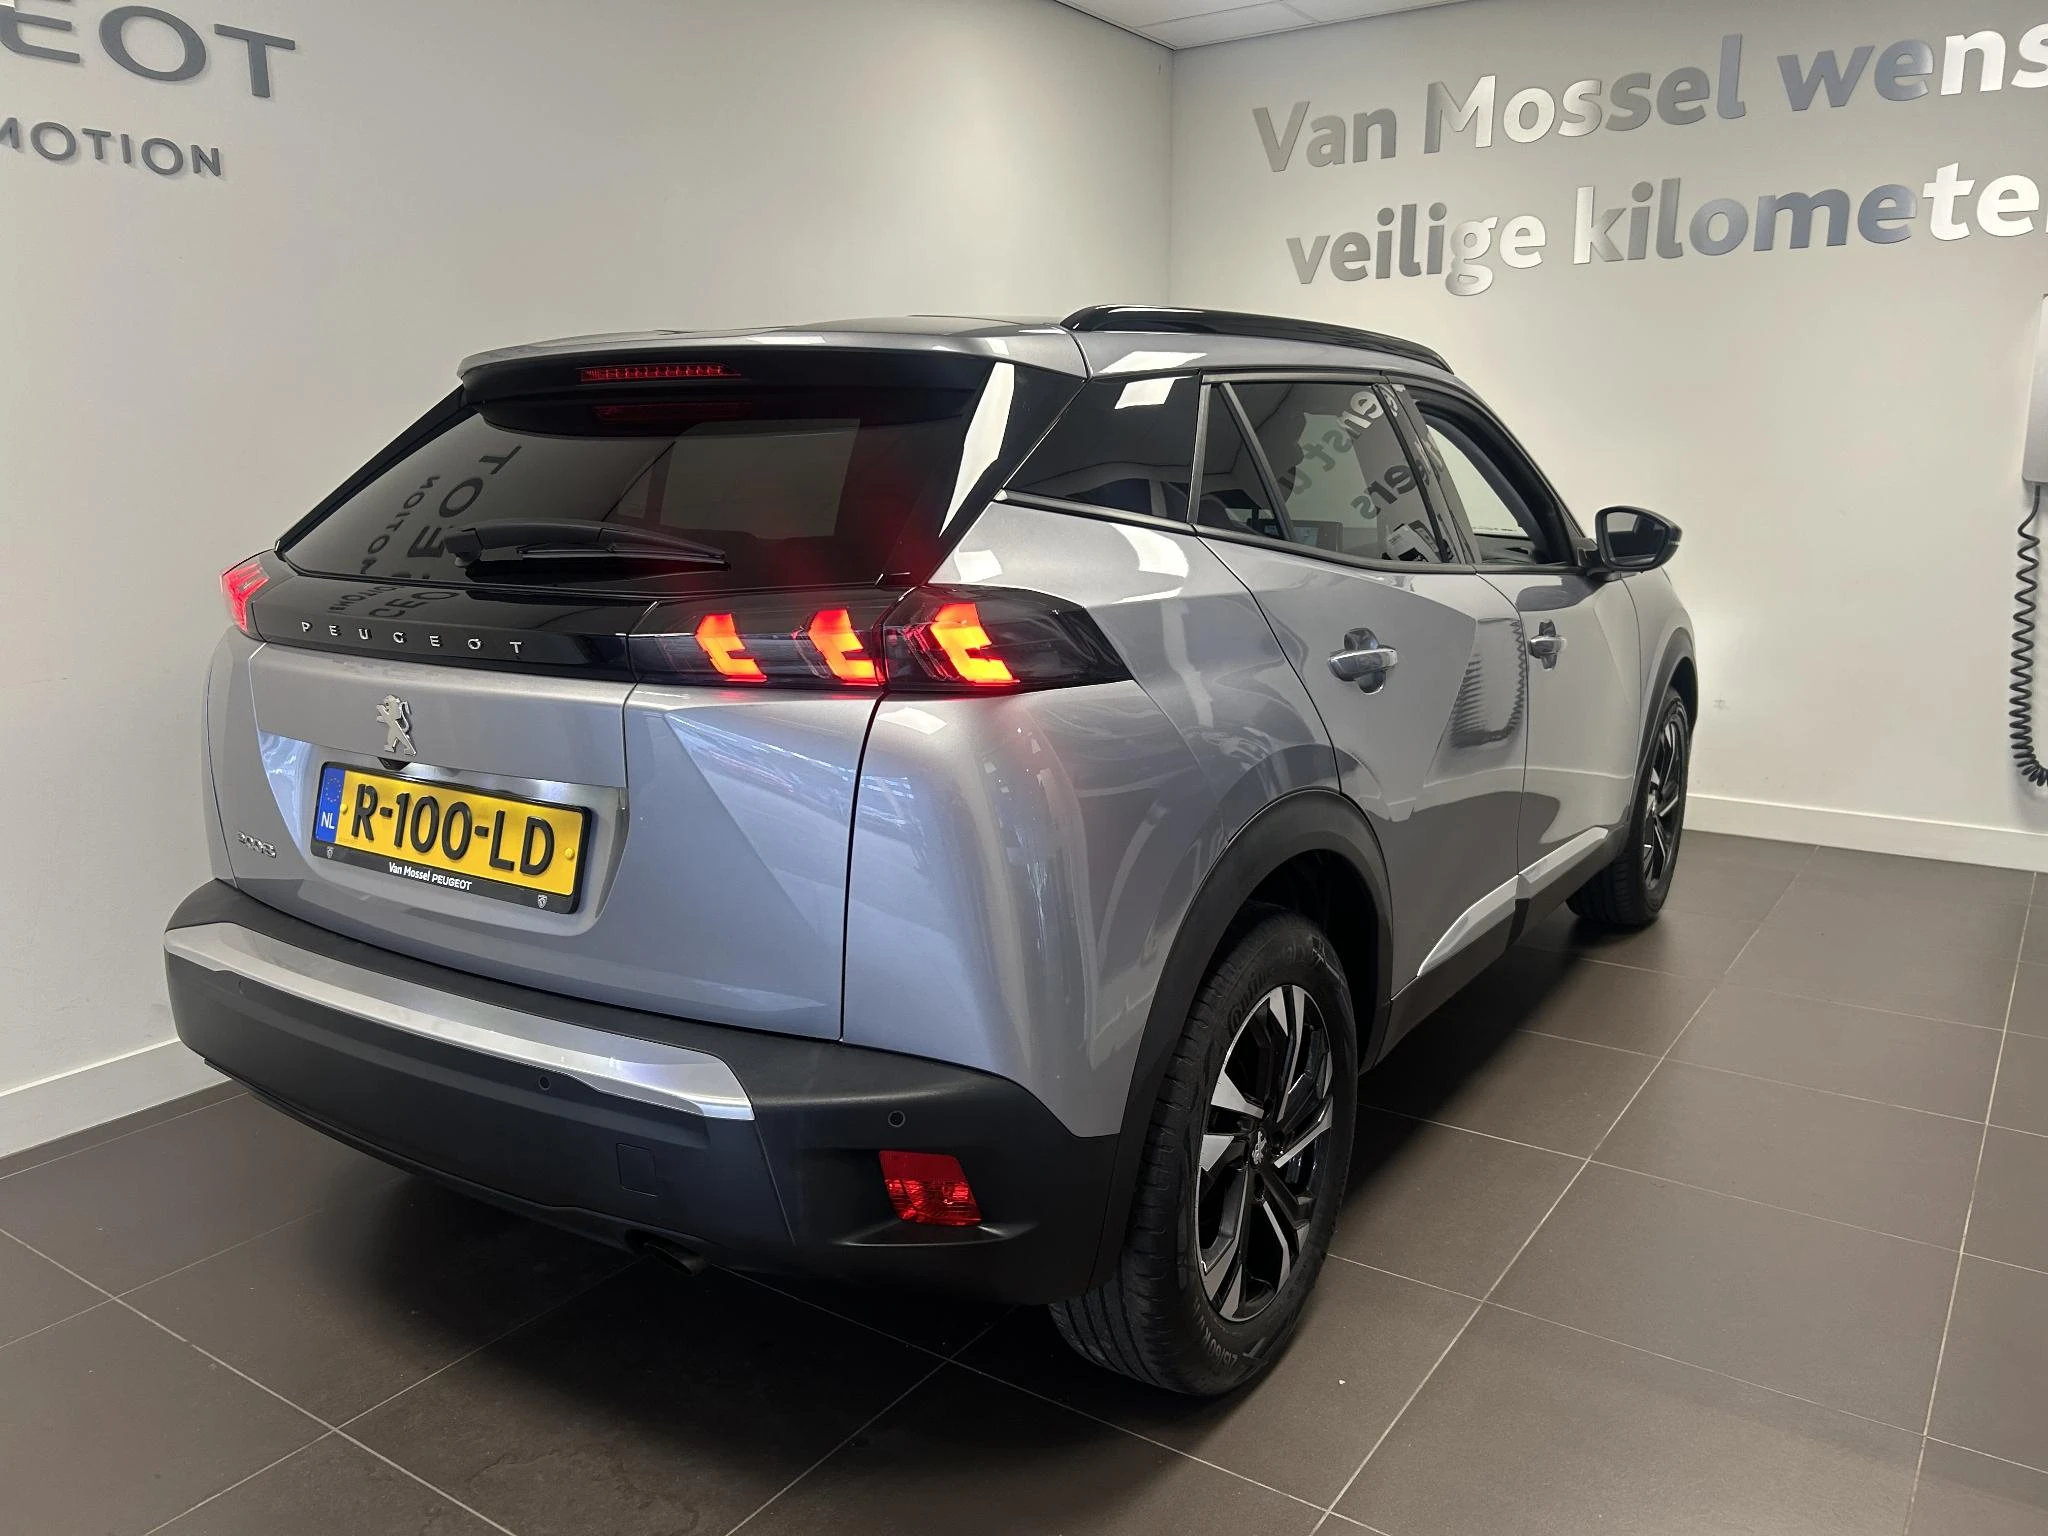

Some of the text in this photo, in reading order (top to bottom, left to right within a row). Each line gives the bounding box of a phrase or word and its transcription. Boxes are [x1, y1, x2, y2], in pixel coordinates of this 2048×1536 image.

[1252, 101, 1397, 172] Van
[1424, 33, 1745, 154] Mossel
[1286, 163, 2048, 297] veilige kilomete
[301, 621, 522, 654] PEUGEOT
[321, 811, 335, 830] NL
[351, 783, 556, 876] R-100-LD
[389, 861, 472, 891] Van Mossel PEUGEOT
